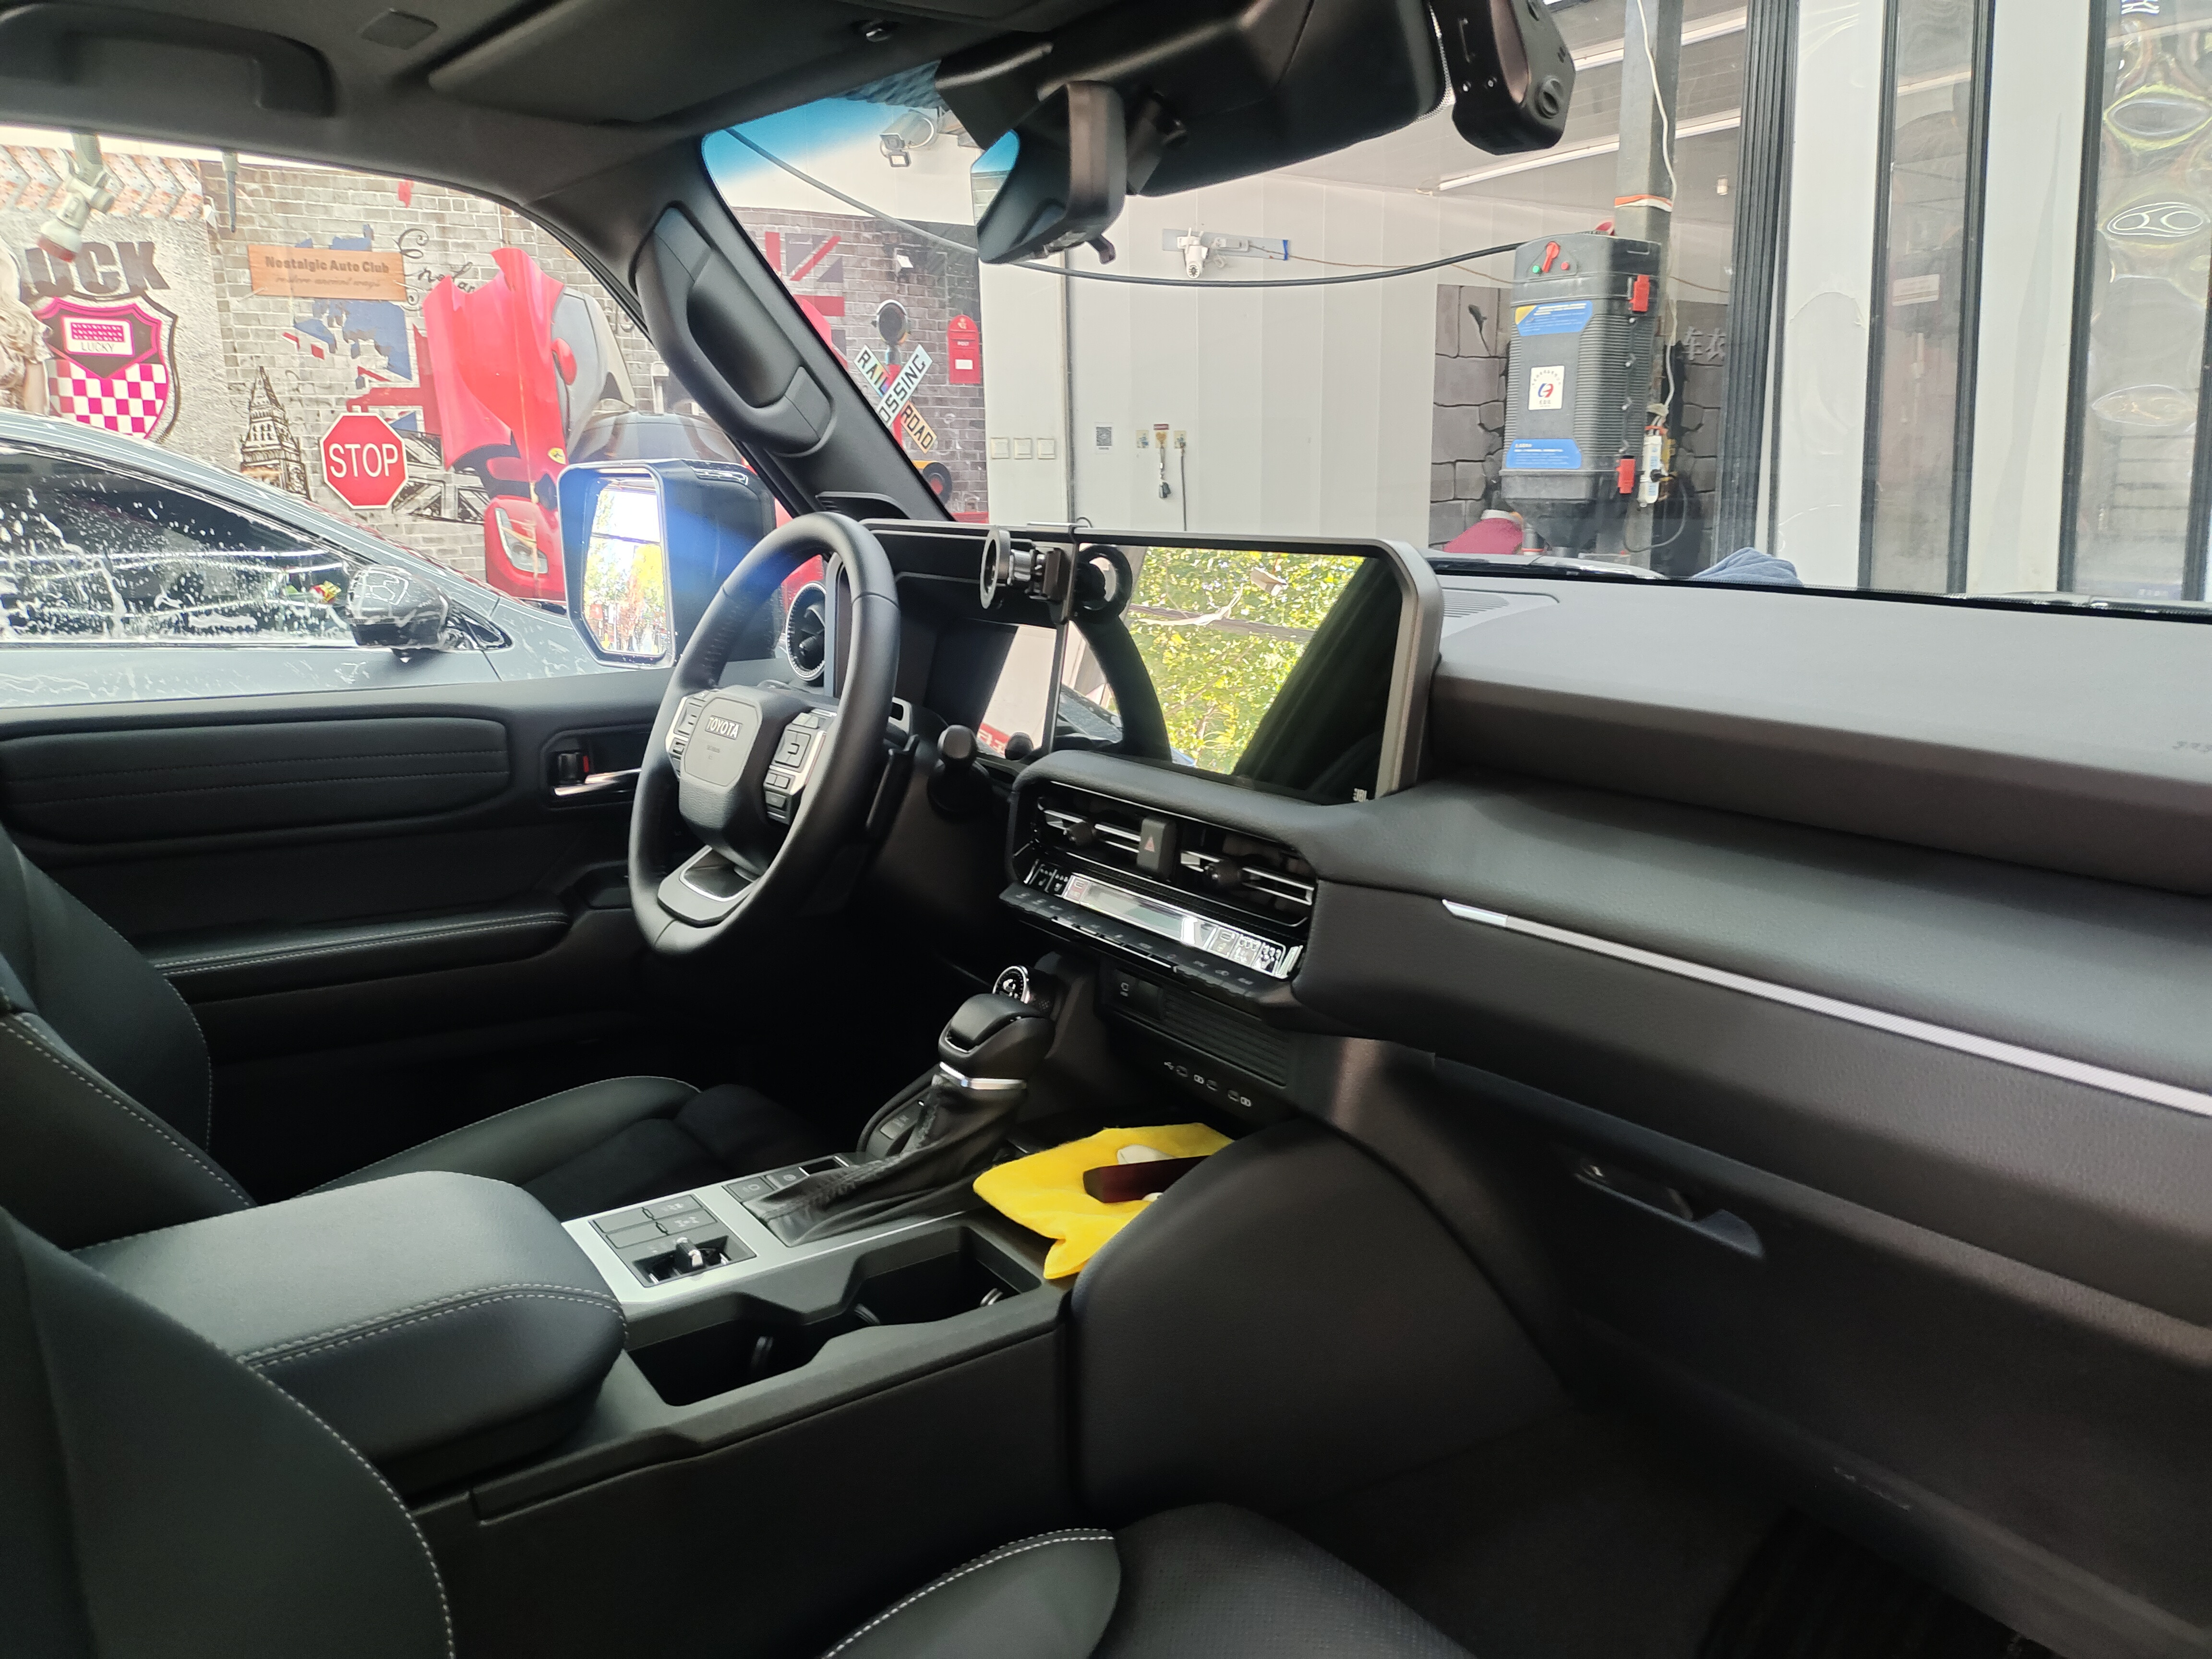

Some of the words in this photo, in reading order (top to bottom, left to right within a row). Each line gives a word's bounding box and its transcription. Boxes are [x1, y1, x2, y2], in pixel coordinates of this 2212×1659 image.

[20, 241, 171, 297] UCK
[265, 256, 327, 272] Nostalgic
[330, 260, 360, 272] Auto
[362, 261, 389, 274] Club
[81, 341, 115, 353] LUCKY
[857, 349, 889, 396] RAIL
[901, 405, 934, 450] ROAD
[878, 354, 926, 424] OSSING
[328, 443, 398, 478] STOP
[706, 717, 739, 738] TOYOTA
